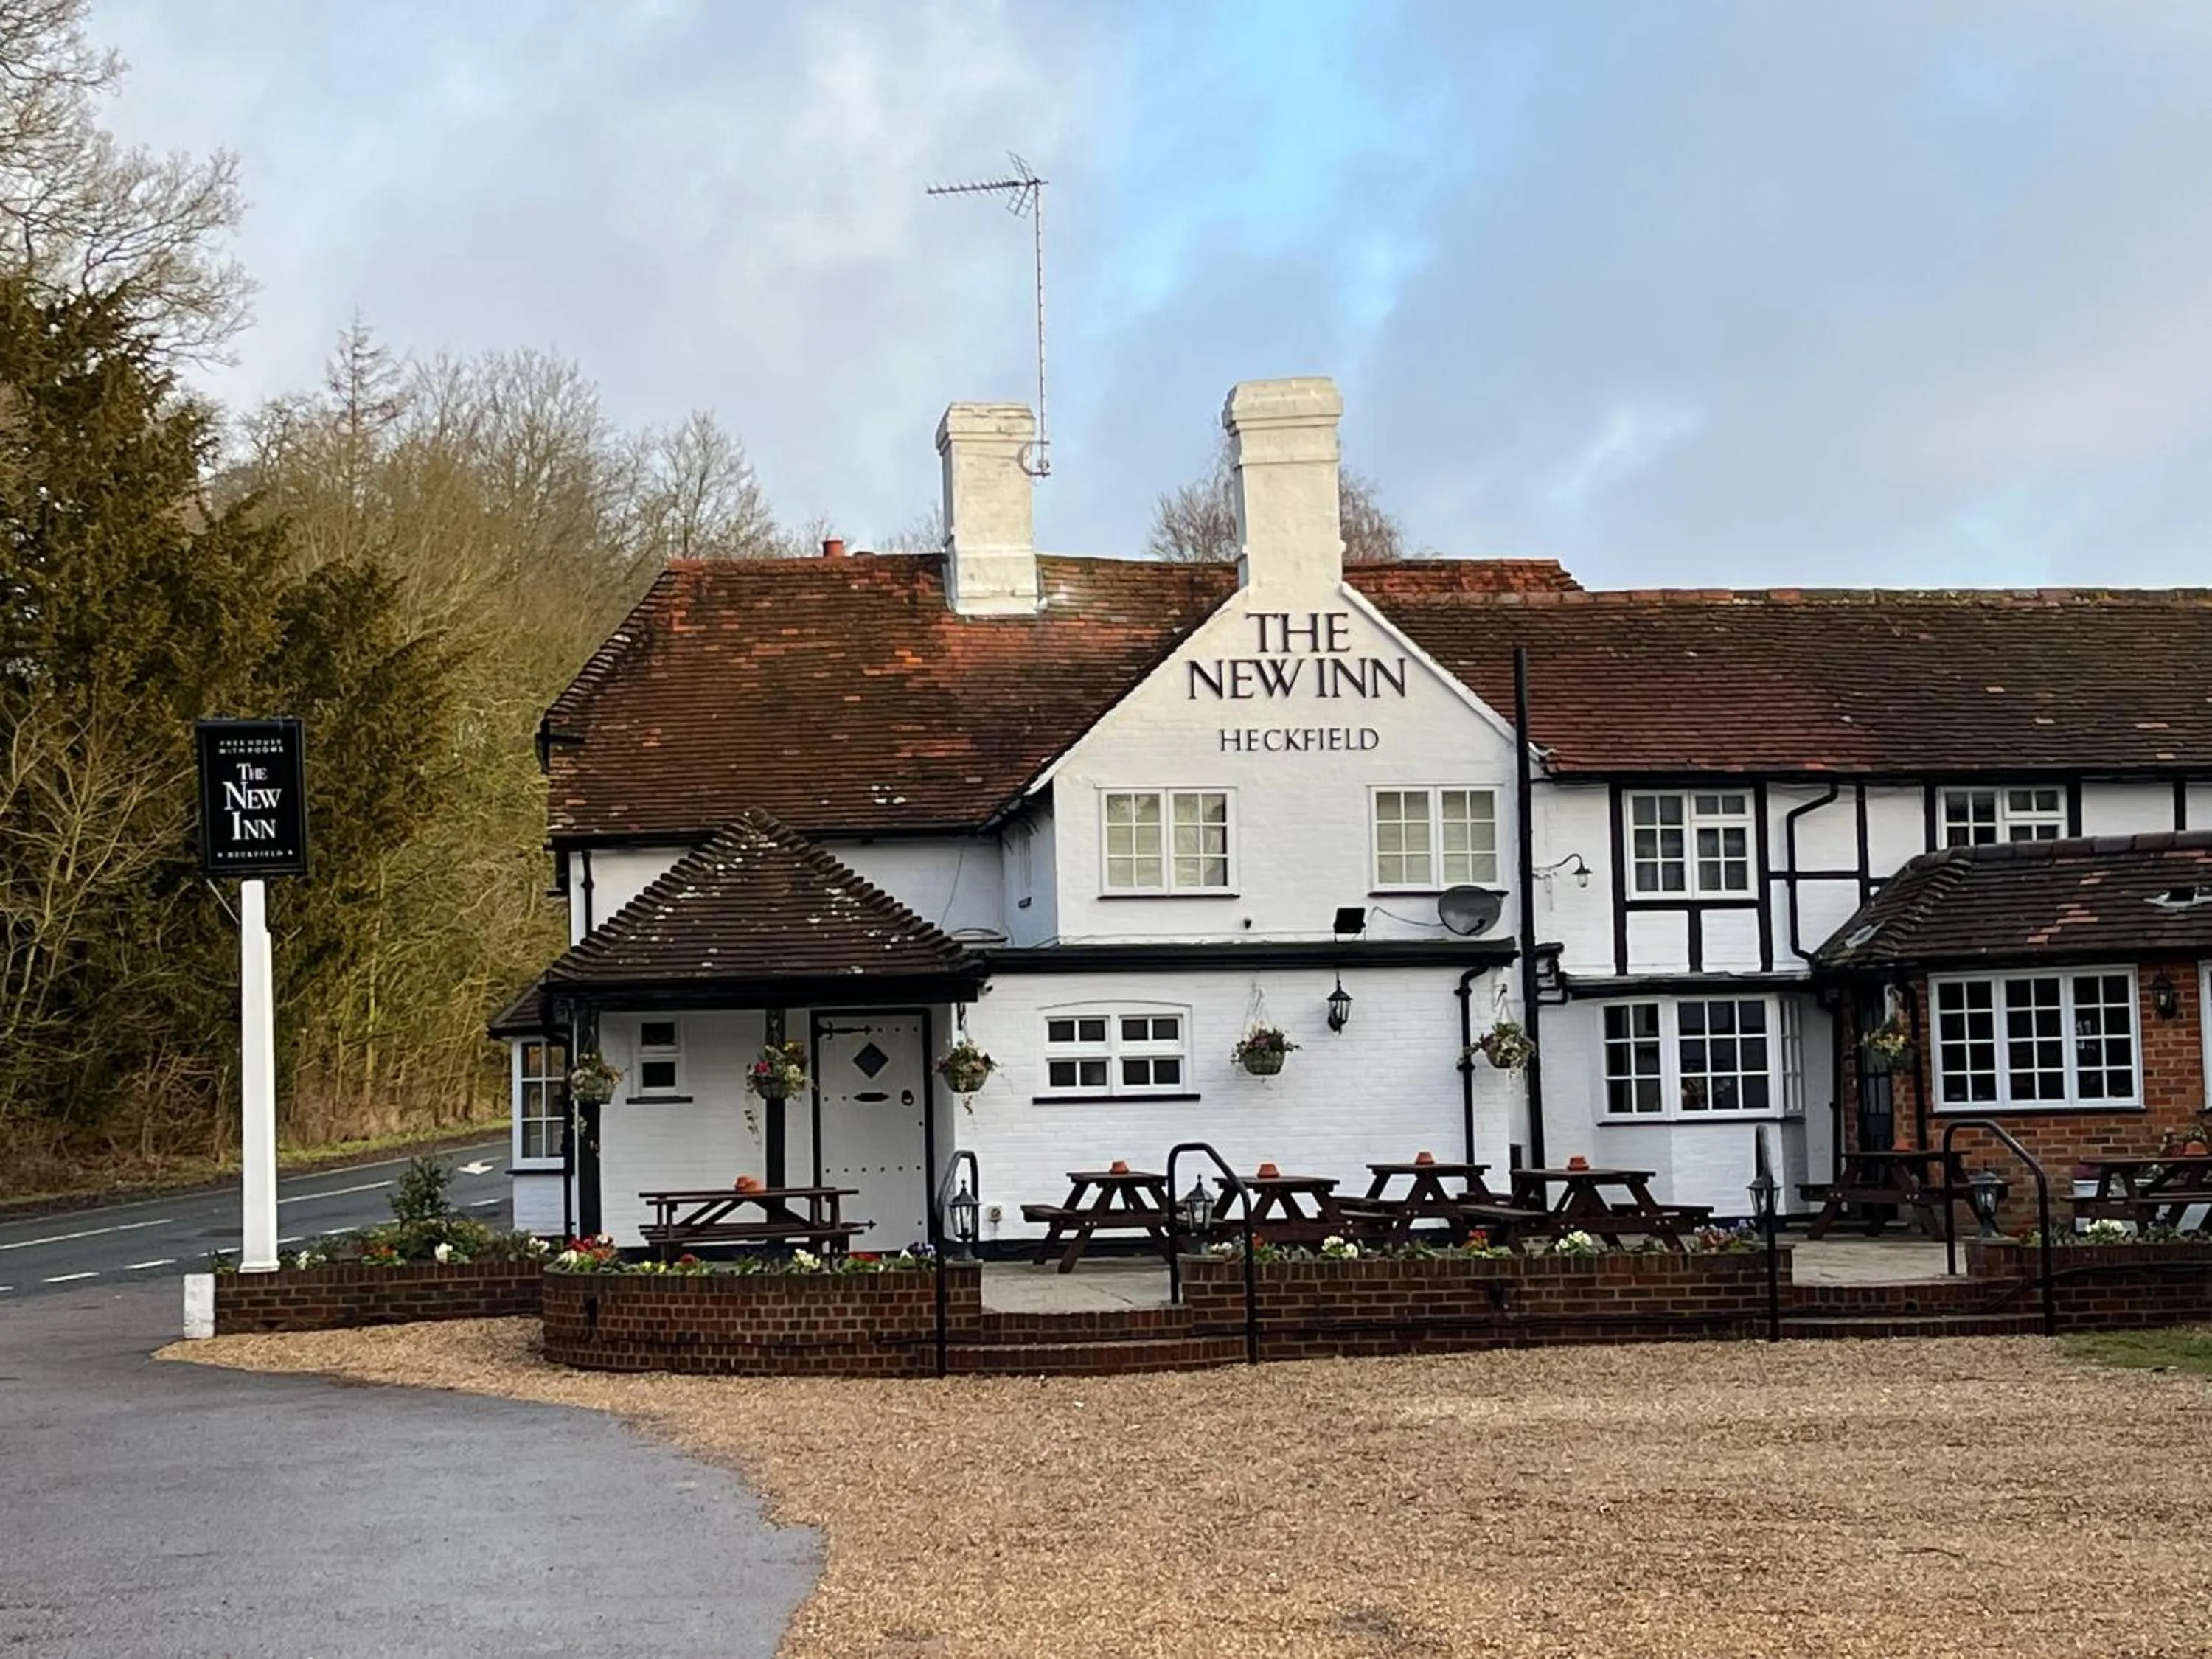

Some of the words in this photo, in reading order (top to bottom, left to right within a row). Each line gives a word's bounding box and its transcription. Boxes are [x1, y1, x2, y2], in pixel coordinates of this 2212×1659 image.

[1246, 613, 1351, 653] THE
[1187, 658, 1304, 700] NEW
[1315, 658, 1406, 698] INN
[1220, 728, 1380, 751] HECKFIELD
[236, 762, 268, 781] THE
[222, 781, 283, 810] NEW
[231, 811, 276, 840] INN
